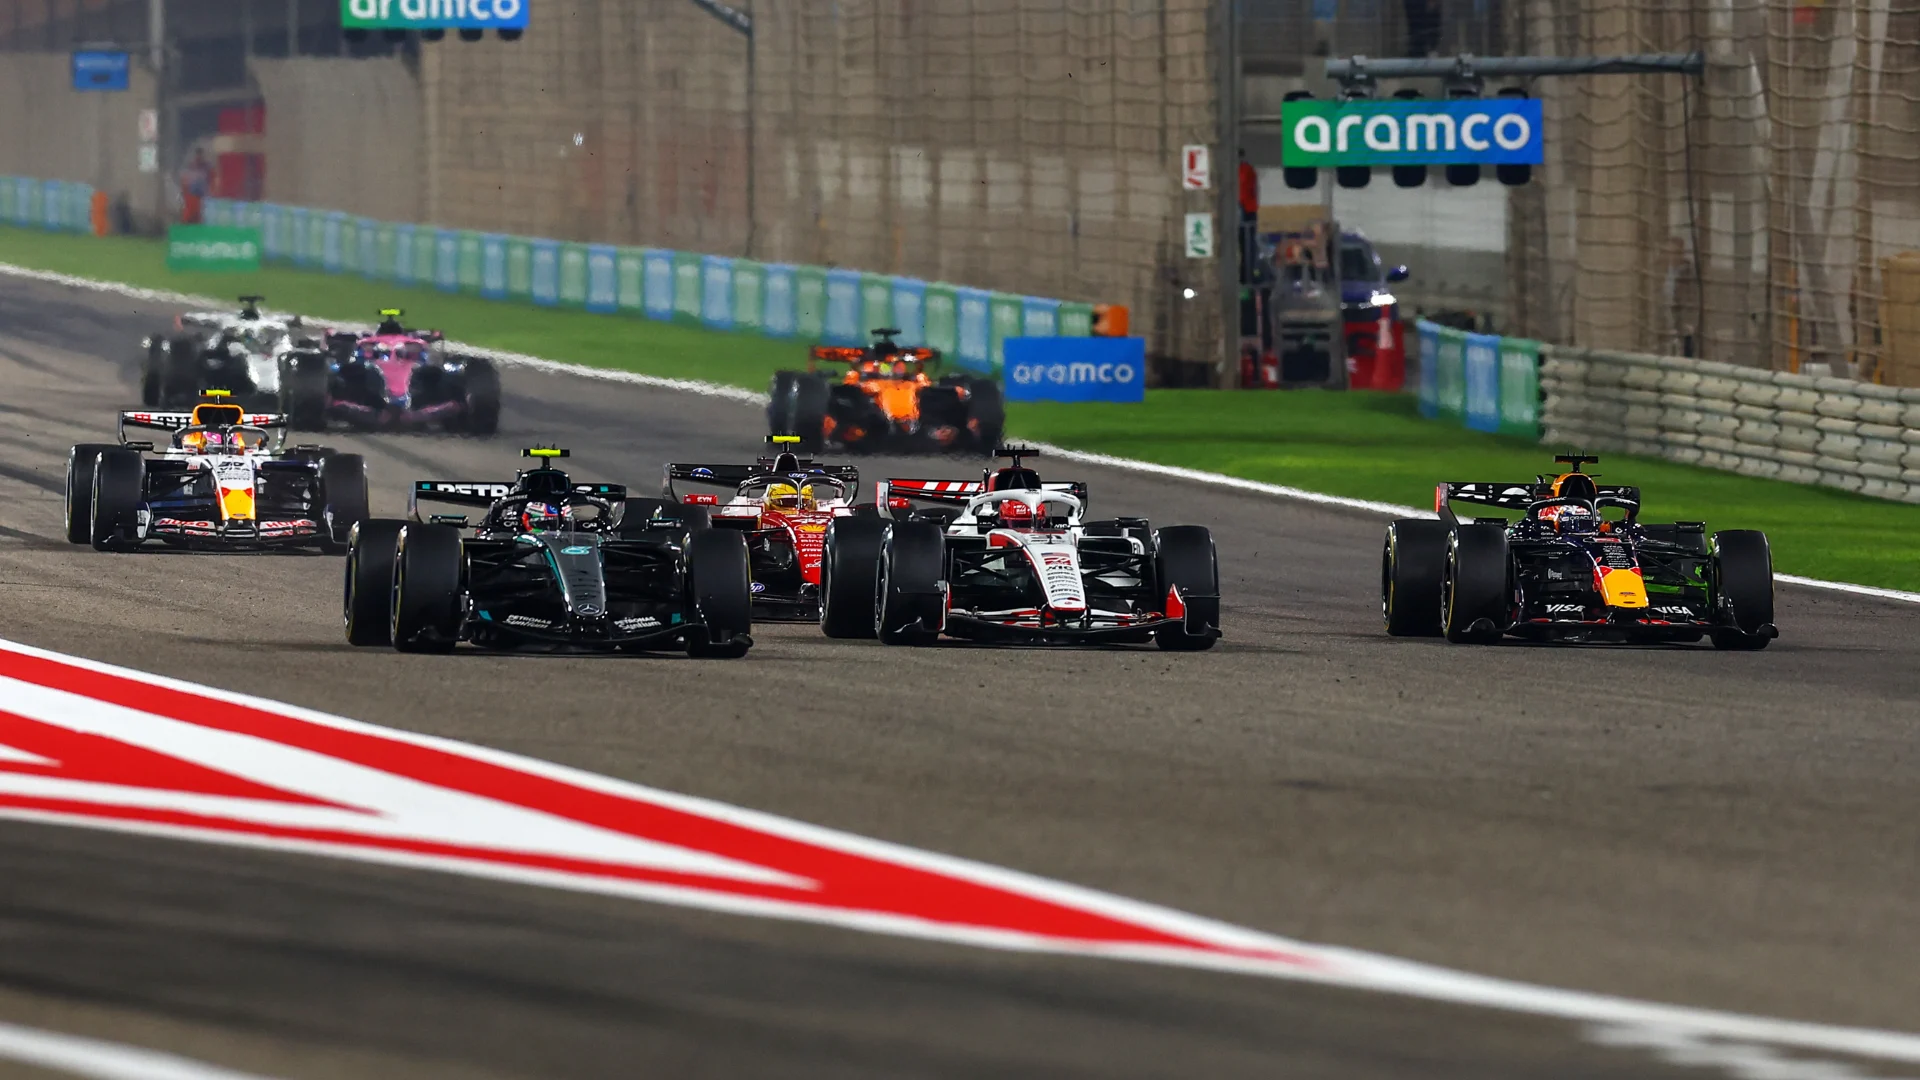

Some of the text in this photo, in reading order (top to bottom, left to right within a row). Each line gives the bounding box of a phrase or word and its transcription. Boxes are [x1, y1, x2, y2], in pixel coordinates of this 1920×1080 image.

[350, 0, 521, 20] aramco
[1294, 113, 1531, 152] aramco
[1013, 362, 1134, 384] aramco
[1545, 603, 1586, 614] VISA
[1651, 606, 1694, 617] VISA
